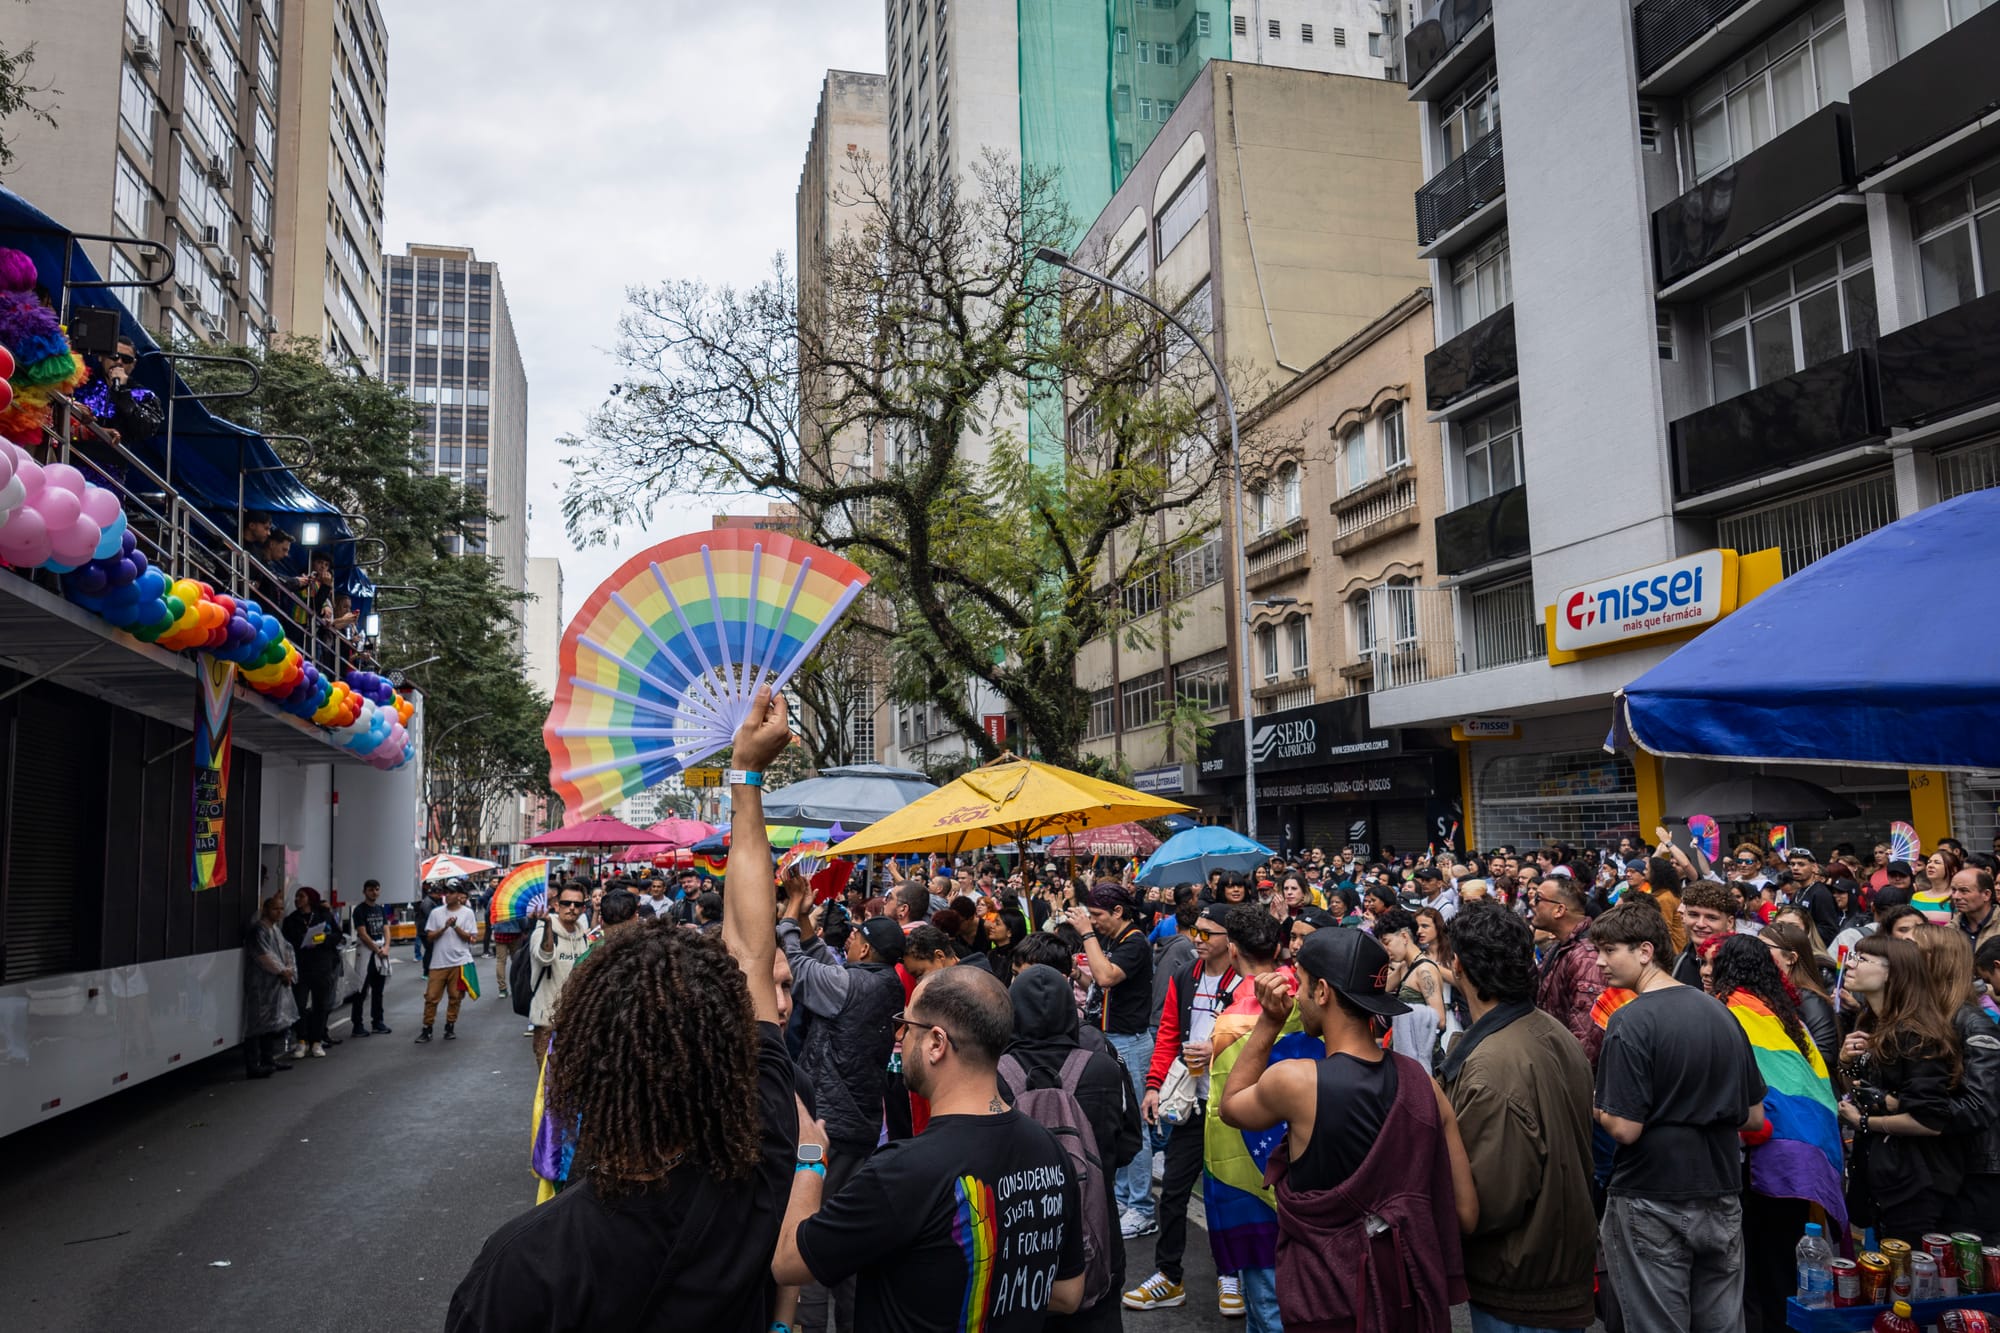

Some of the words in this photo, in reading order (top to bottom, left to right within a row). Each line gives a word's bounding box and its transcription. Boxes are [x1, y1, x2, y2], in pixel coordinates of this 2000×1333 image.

[1597, 566, 1703, 624] nissei
[1623, 617, 1642, 632] mais
[1644, 615, 1660, 630] que
[1662, 606, 1702, 624] farmácia
[1276, 718, 1316, 746] SEBO
[1479, 721, 1509, 730] nissei
[1278, 740, 1316, 758] KAPRICHO
[1305, 782, 1330, 795] REVISTAS
[1333, 780, 1349, 793] DVDS
[1352, 779, 1364, 792] CDS
[1368, 778, 1391, 791] DISCOS
[933, 808, 990, 828] SKOL
[1090, 842, 1134, 855] BRAHMA
[1003, 1199, 1034, 1228] JUSTA
[1002, 1236, 1009, 1260] A
[1018, 1227, 1053, 1255] FORMA
[993, 1263, 1056, 1318] AMOR
